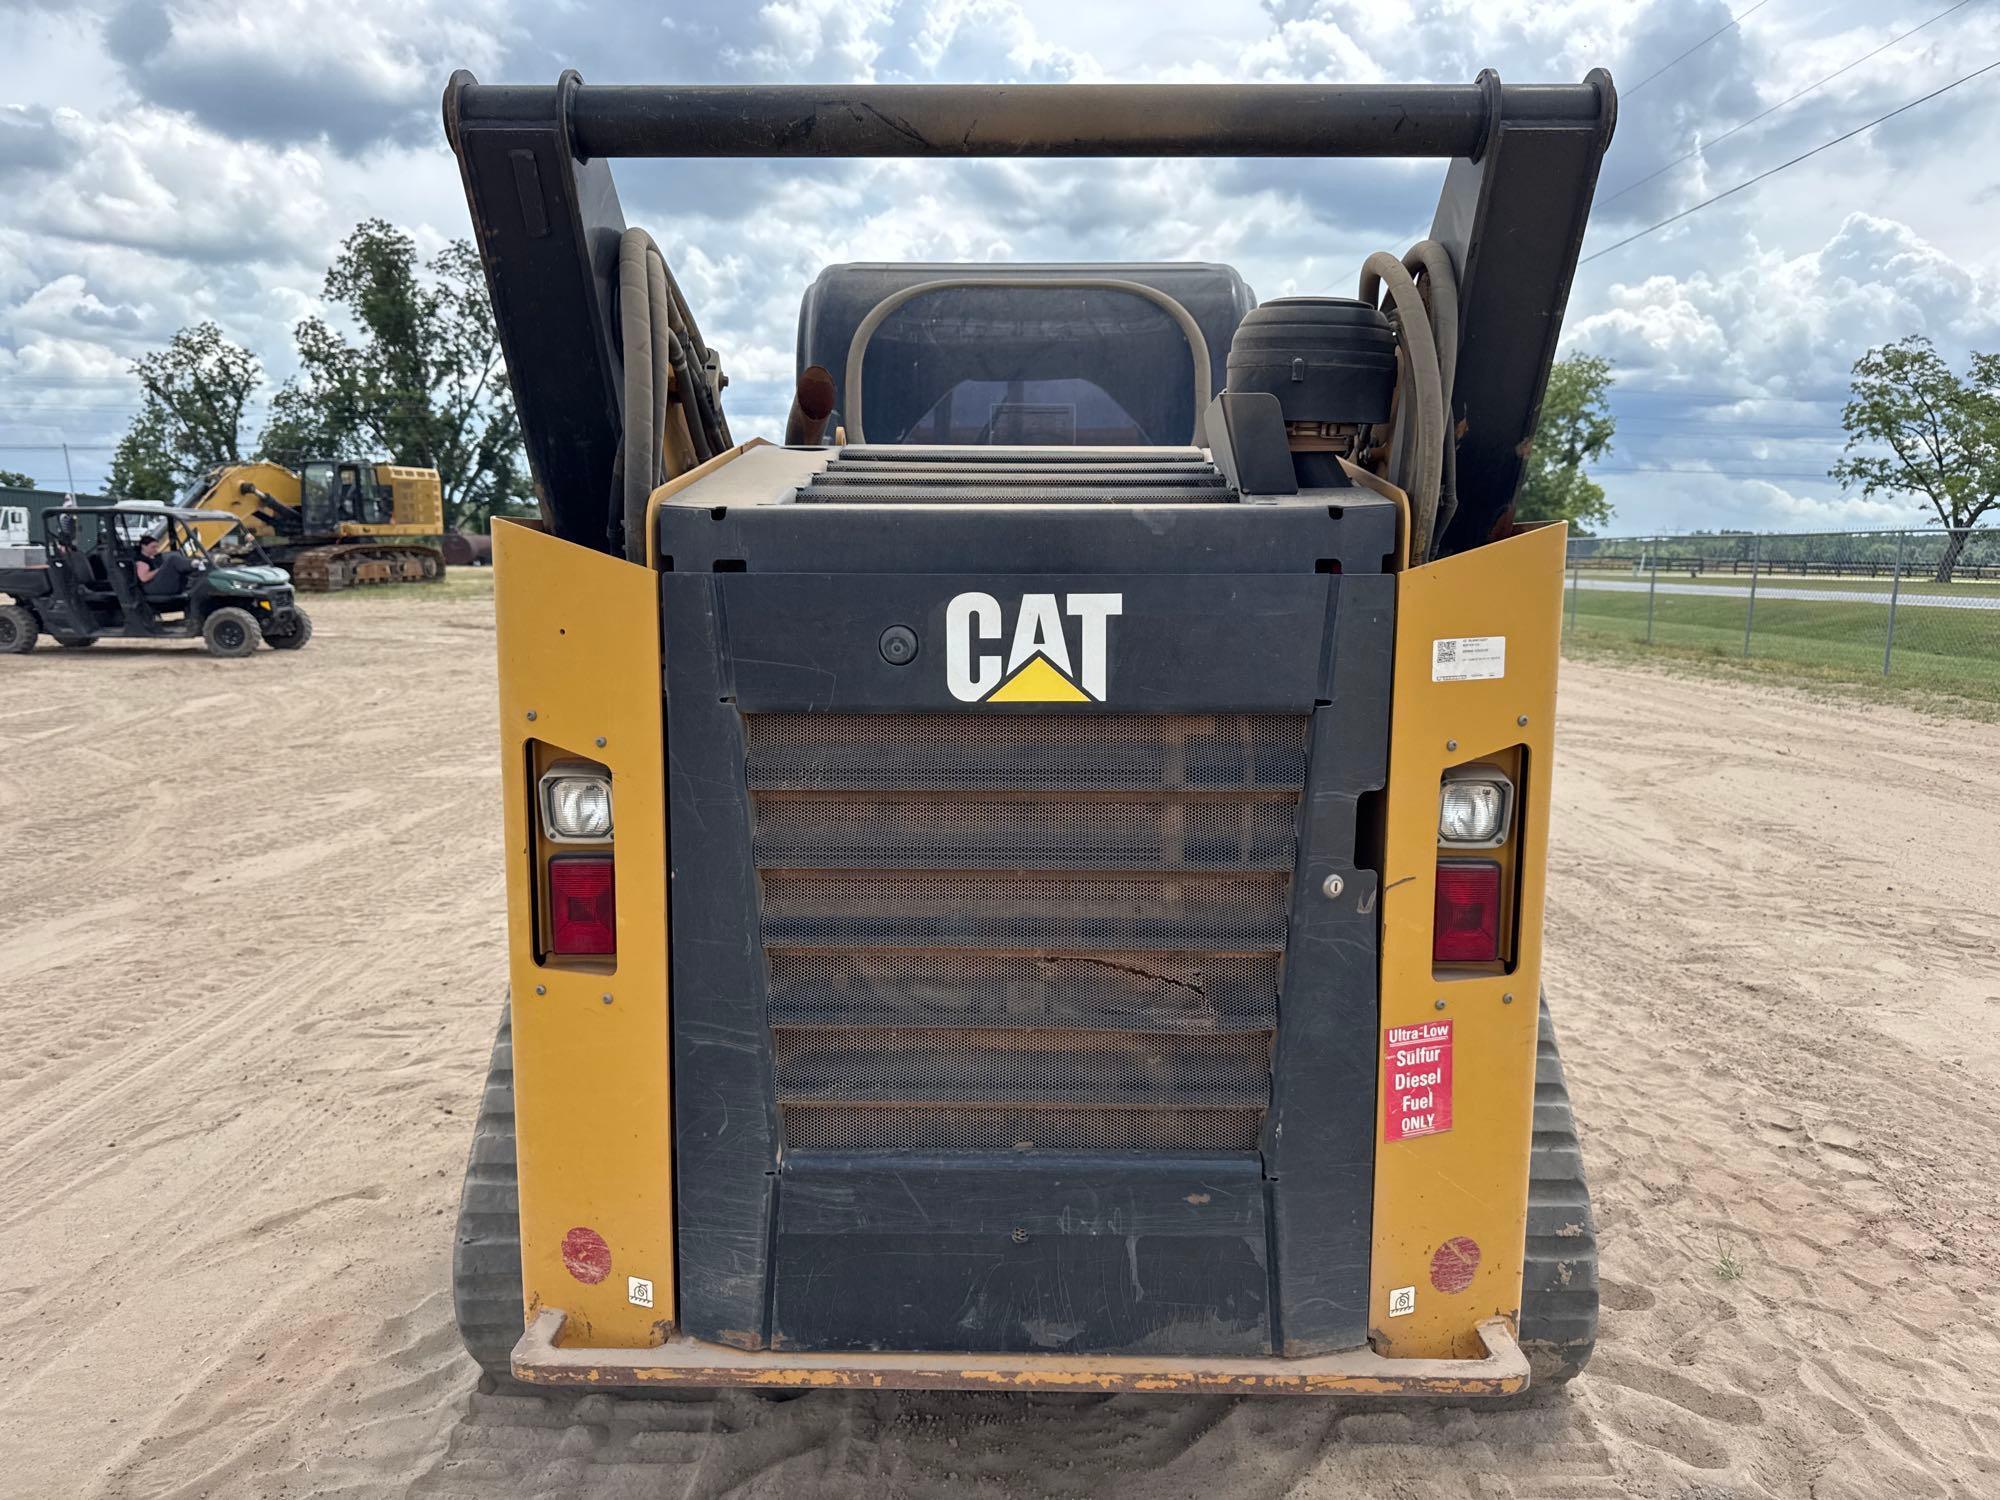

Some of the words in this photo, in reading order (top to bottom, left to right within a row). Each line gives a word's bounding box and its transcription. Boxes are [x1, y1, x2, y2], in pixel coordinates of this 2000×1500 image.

[946, 592, 1122, 702] CAT
[1389, 1025, 1448, 1043] Ultra-Low
[1396, 1047, 1440, 1067] Sulfur
[1395, 1067, 1441, 1090] Diesel
[1402, 1091, 1433, 1112] Fuel
[1401, 1113, 1435, 1132] ONLY
